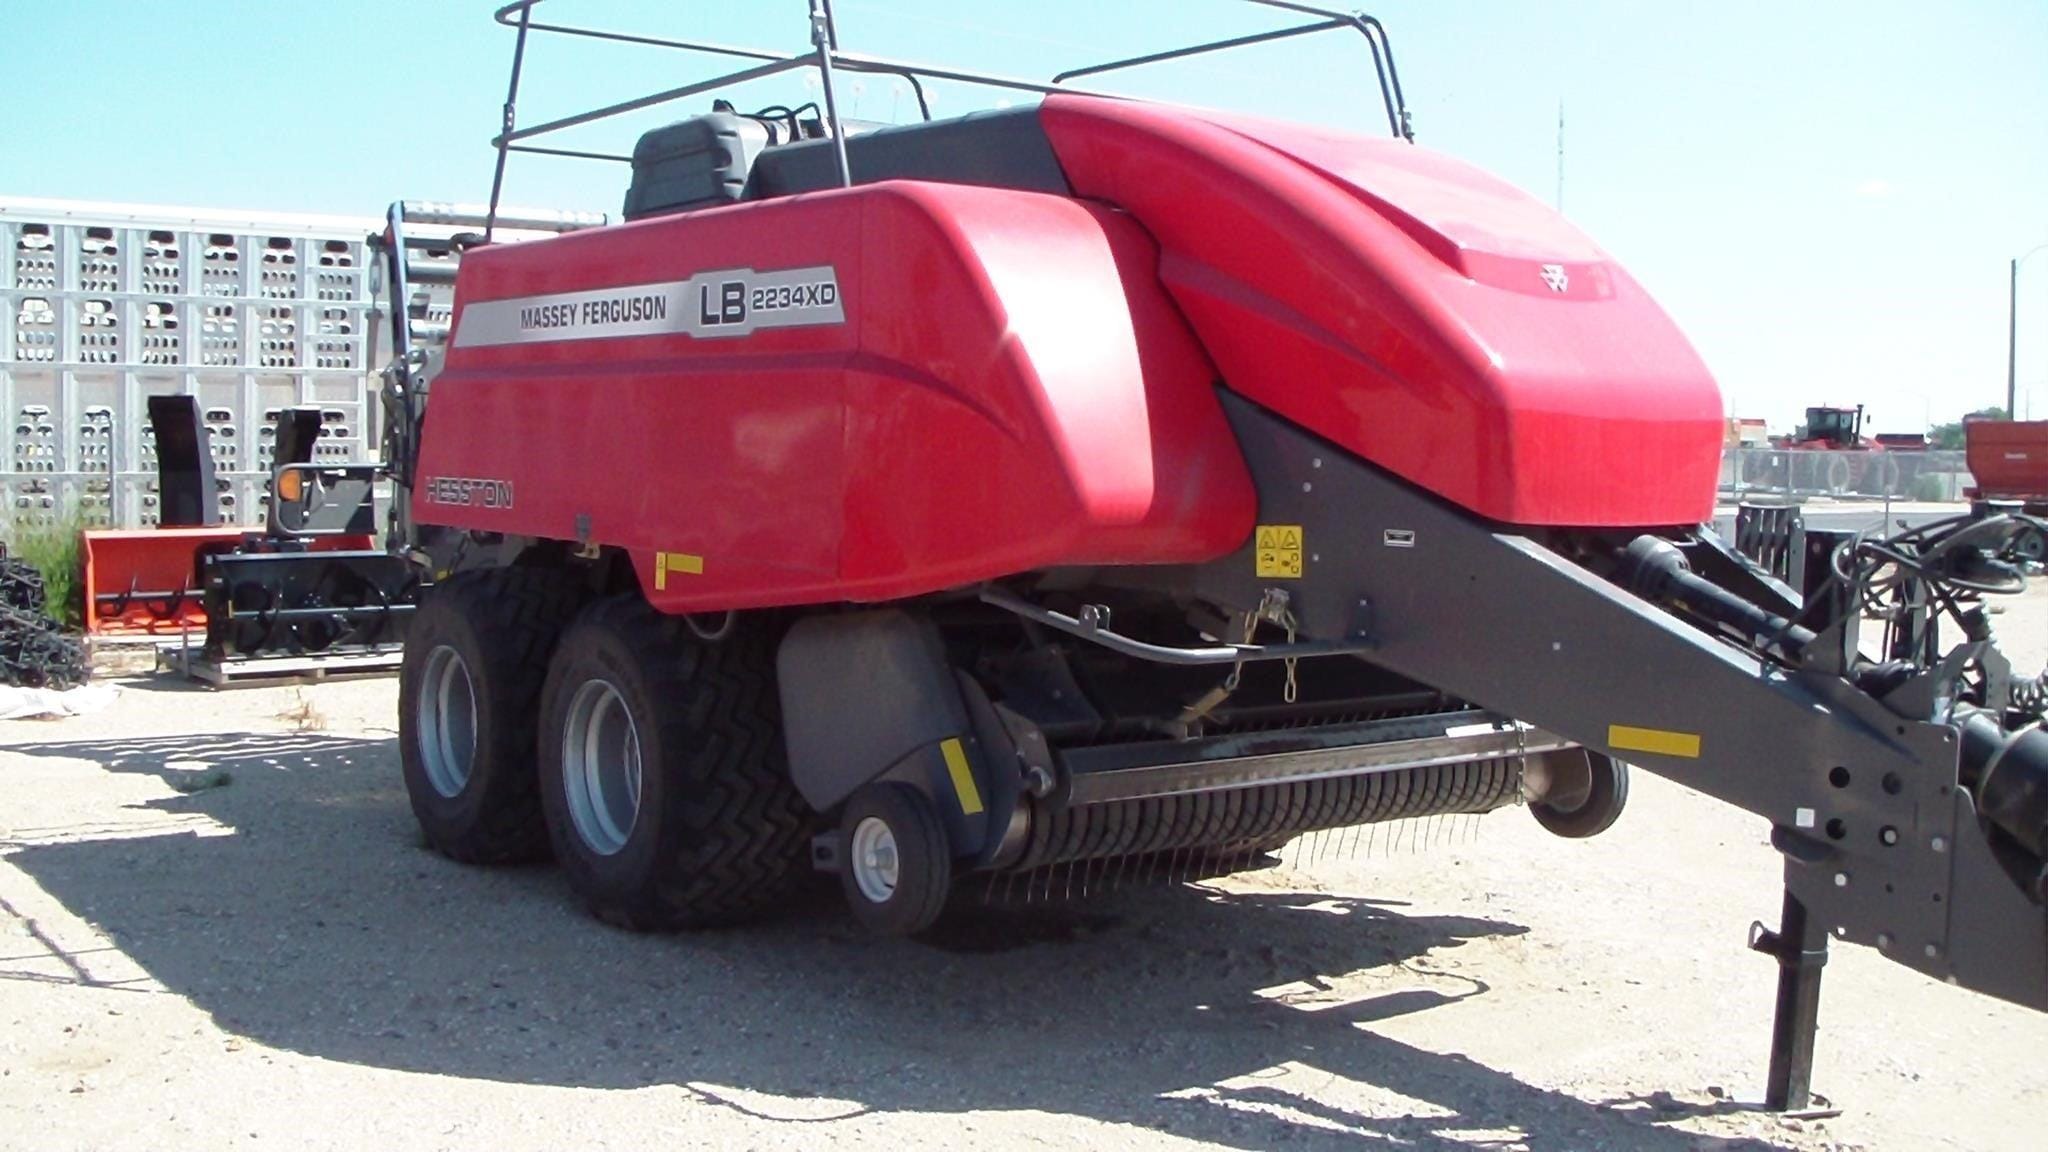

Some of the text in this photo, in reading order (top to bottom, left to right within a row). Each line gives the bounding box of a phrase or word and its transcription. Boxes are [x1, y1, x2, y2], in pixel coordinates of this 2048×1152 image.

[520, 281, 836, 329] MASSEY FERGUSON LB 2234XD
[425, 476, 513, 509] HESSTON
